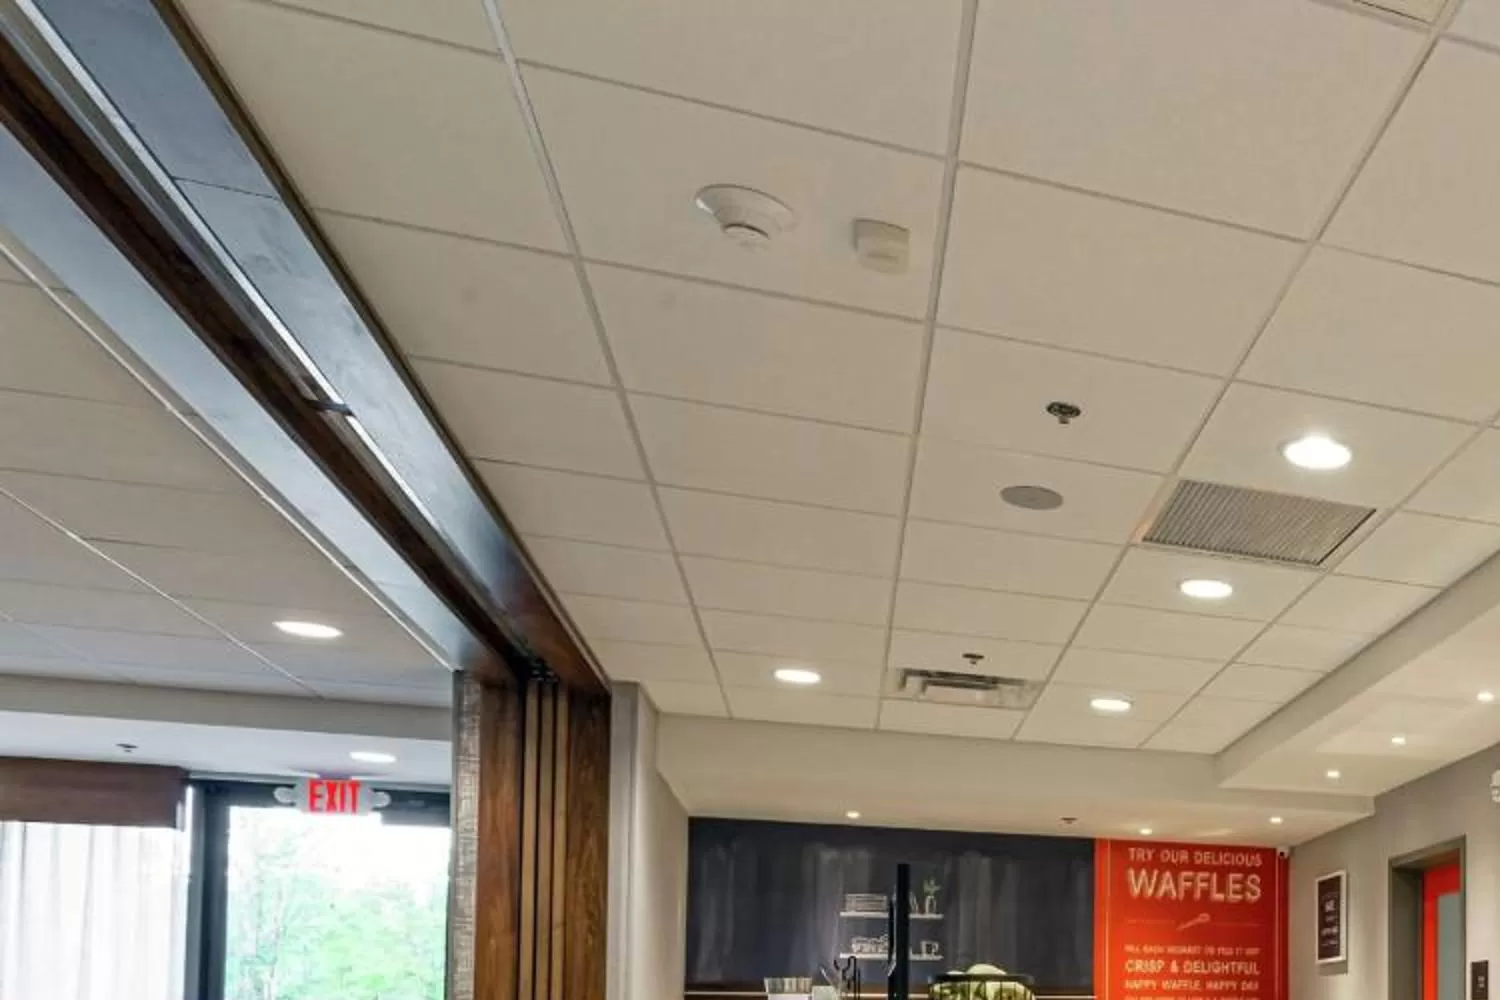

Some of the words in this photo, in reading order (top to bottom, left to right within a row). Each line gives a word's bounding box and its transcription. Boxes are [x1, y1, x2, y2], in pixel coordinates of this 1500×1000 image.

[308, 780, 361, 815] EXIT
[1128, 847, 1153, 863] TRY
[1160, 849, 1189, 865] OUR
[1193, 851, 1263, 868] DELICIOUS
[1127, 867, 1262, 903] WAFFLES
[1125, 959, 1165, 973] CRISP
[1183, 960, 1260, 975] DELIGHTFUL
